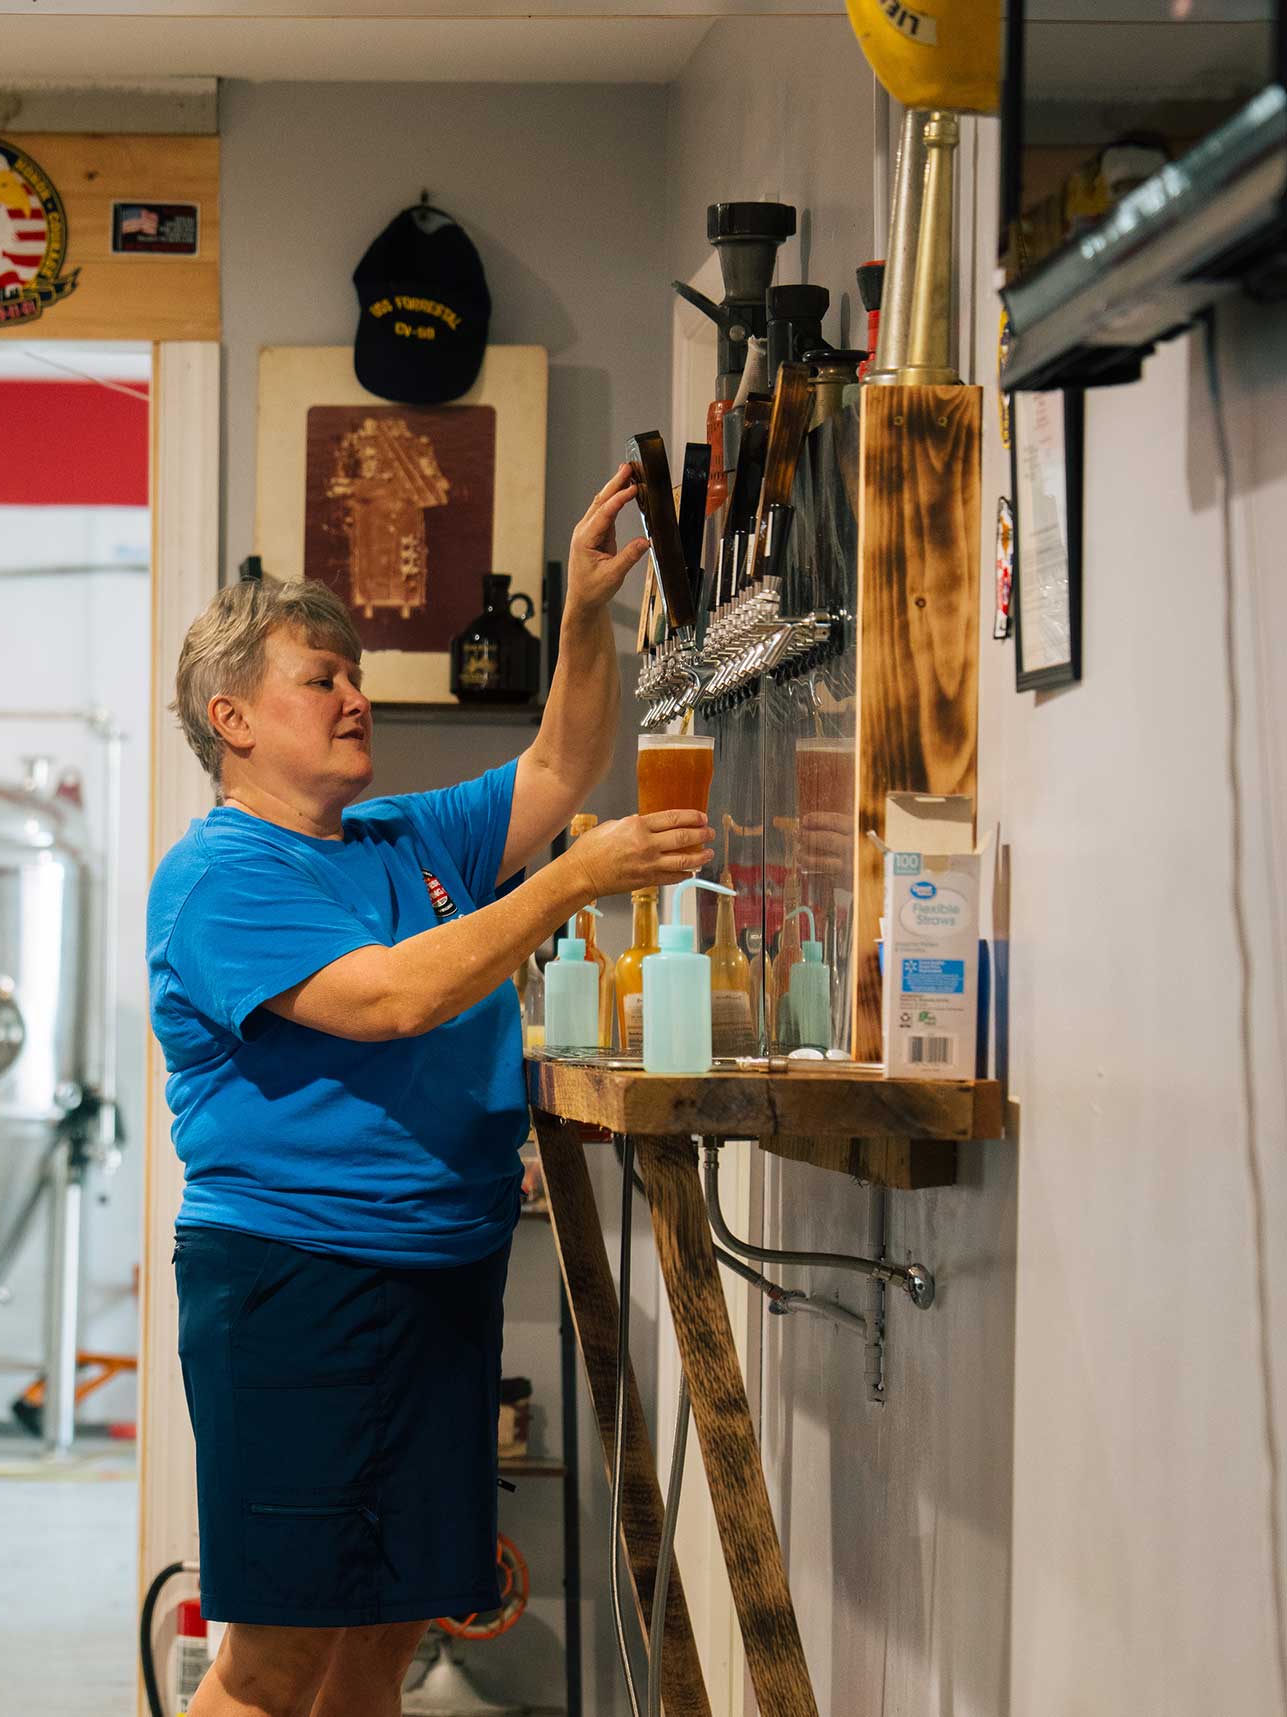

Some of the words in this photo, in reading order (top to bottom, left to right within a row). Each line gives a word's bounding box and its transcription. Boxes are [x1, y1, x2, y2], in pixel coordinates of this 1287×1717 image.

[15, 159, 52, 201] HONOR
[43, 210, 62, 277] COURAGE
[895, 853, 919, 869] 100
[912, 902, 961, 915] Flexible
[916, 914, 956, 928] Straws
